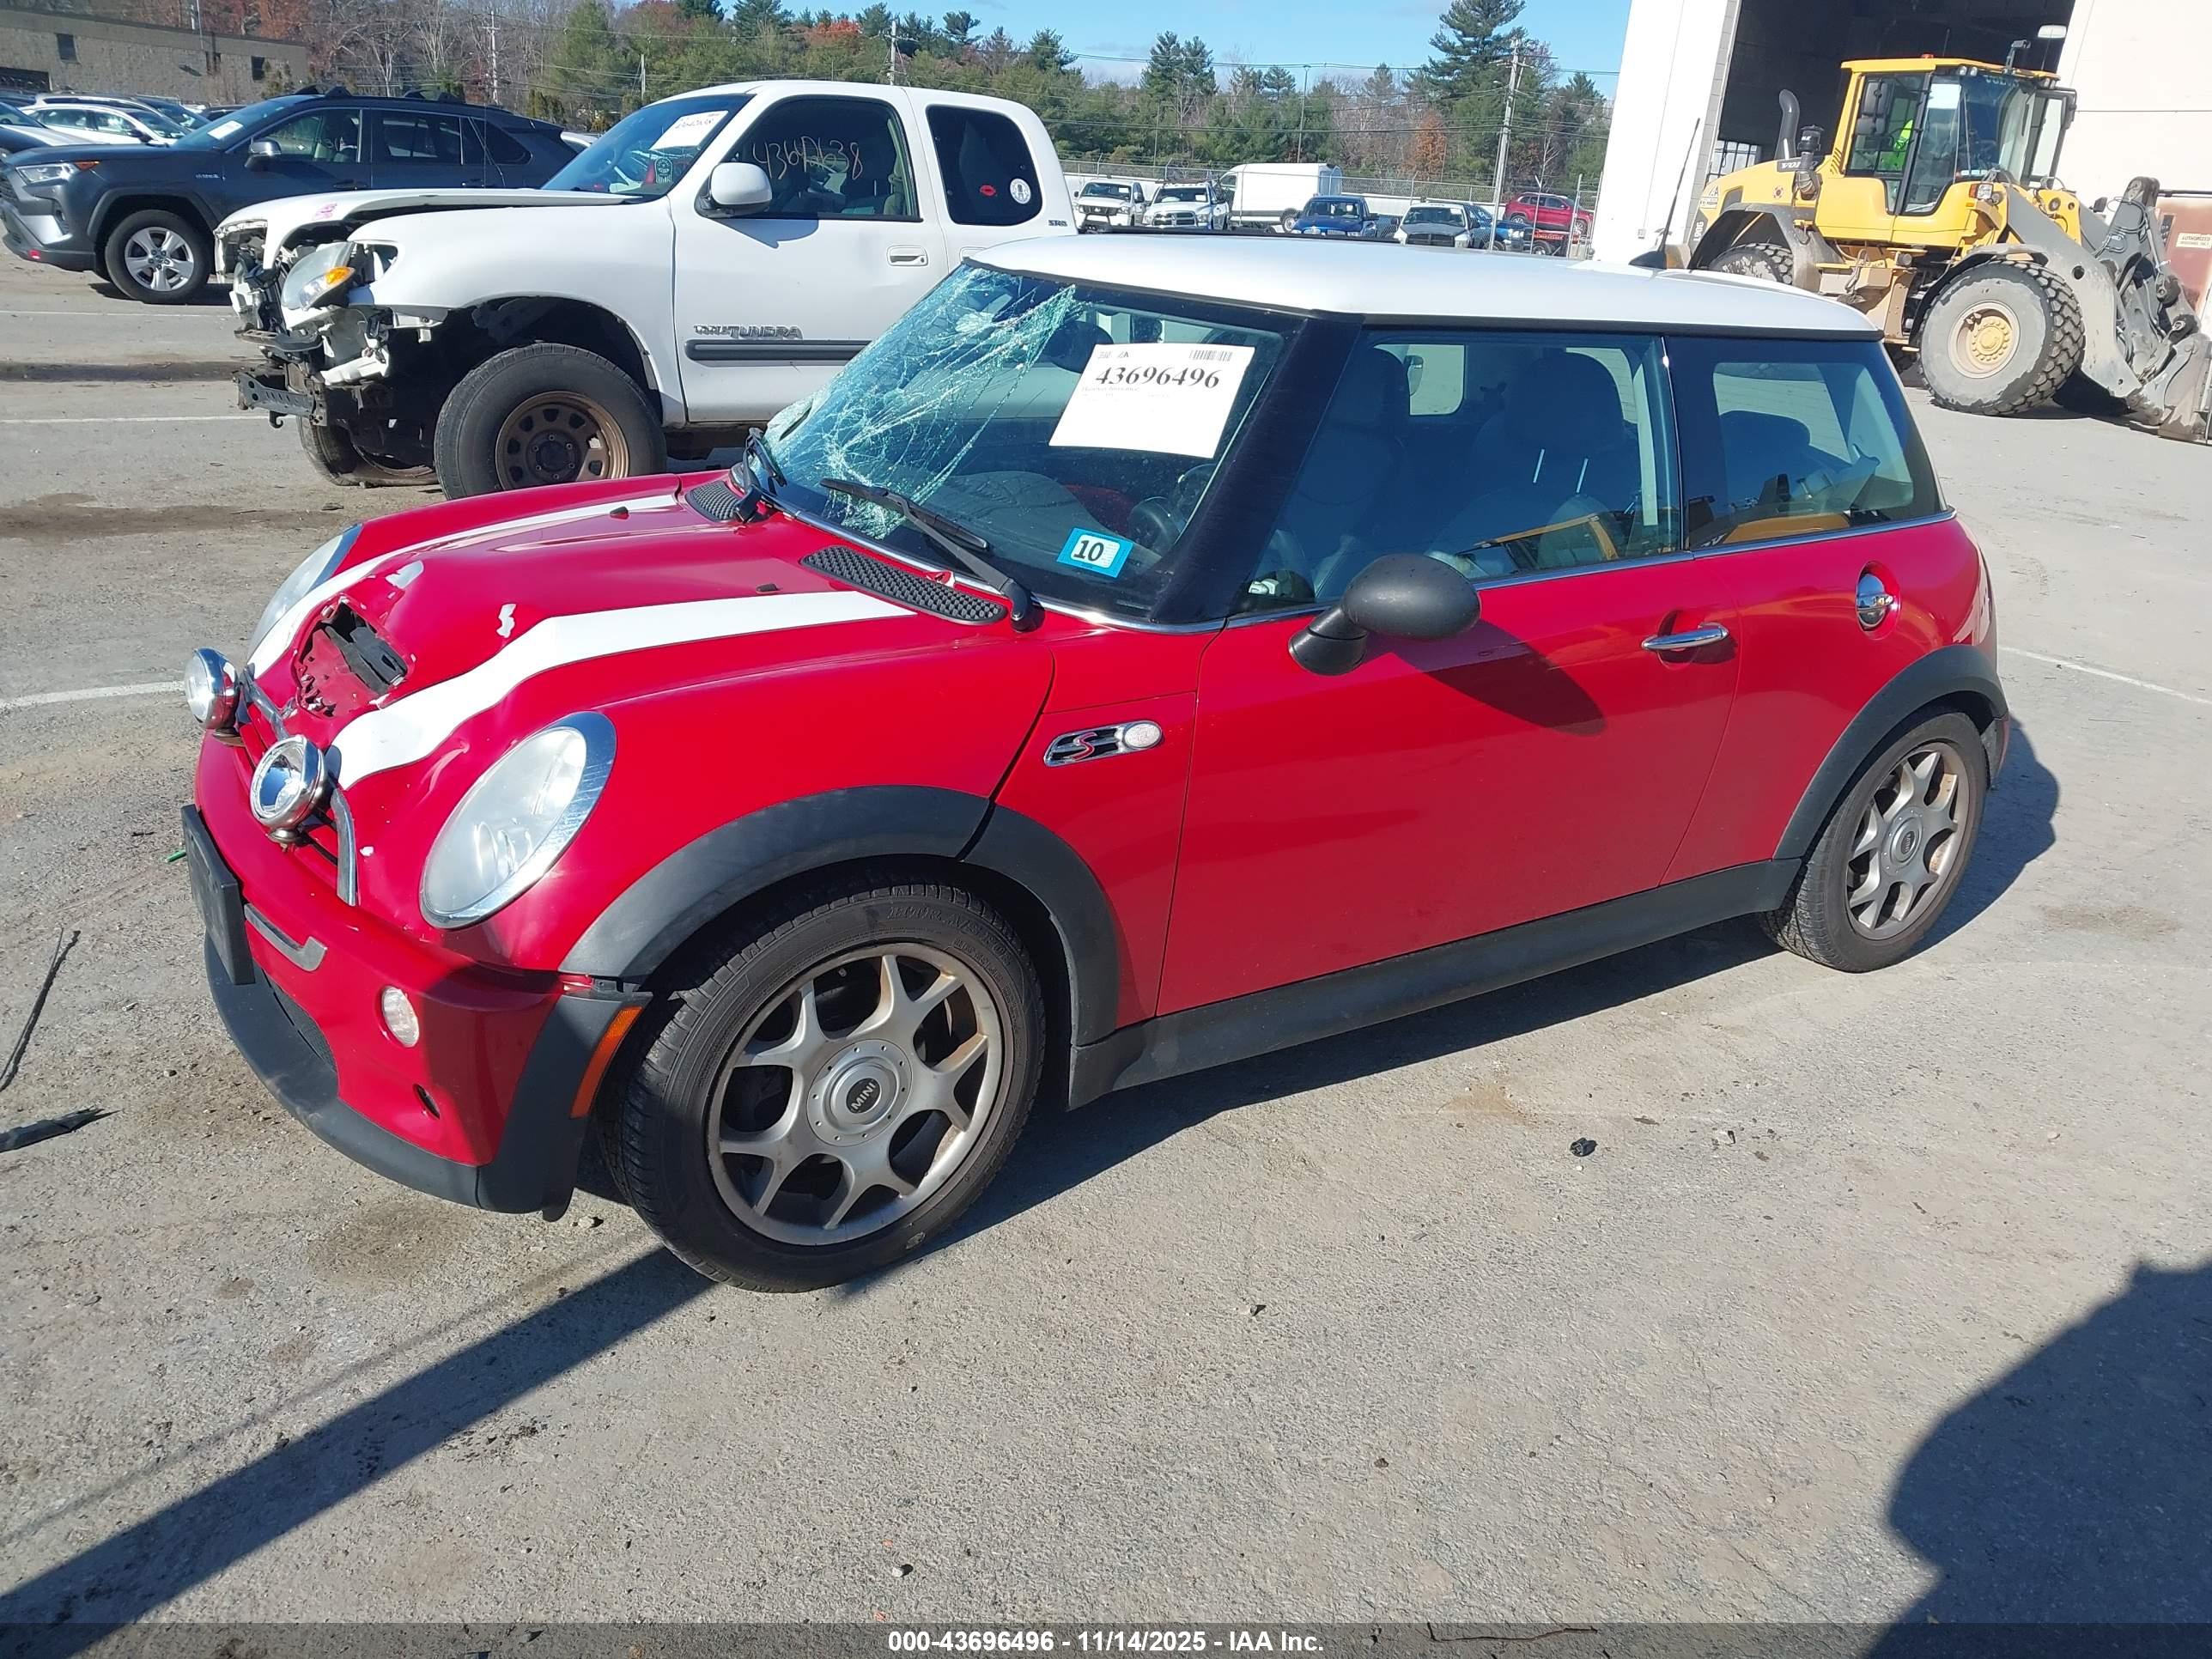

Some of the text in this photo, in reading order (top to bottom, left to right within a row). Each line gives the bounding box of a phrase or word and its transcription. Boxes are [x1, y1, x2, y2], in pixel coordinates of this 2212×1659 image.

[728, 325, 804, 340] TUNDRA
[1095, 366, 1223, 389] 43696496
[1073, 539, 1104, 562] 10
[850, 1082, 877, 1110] MINI
